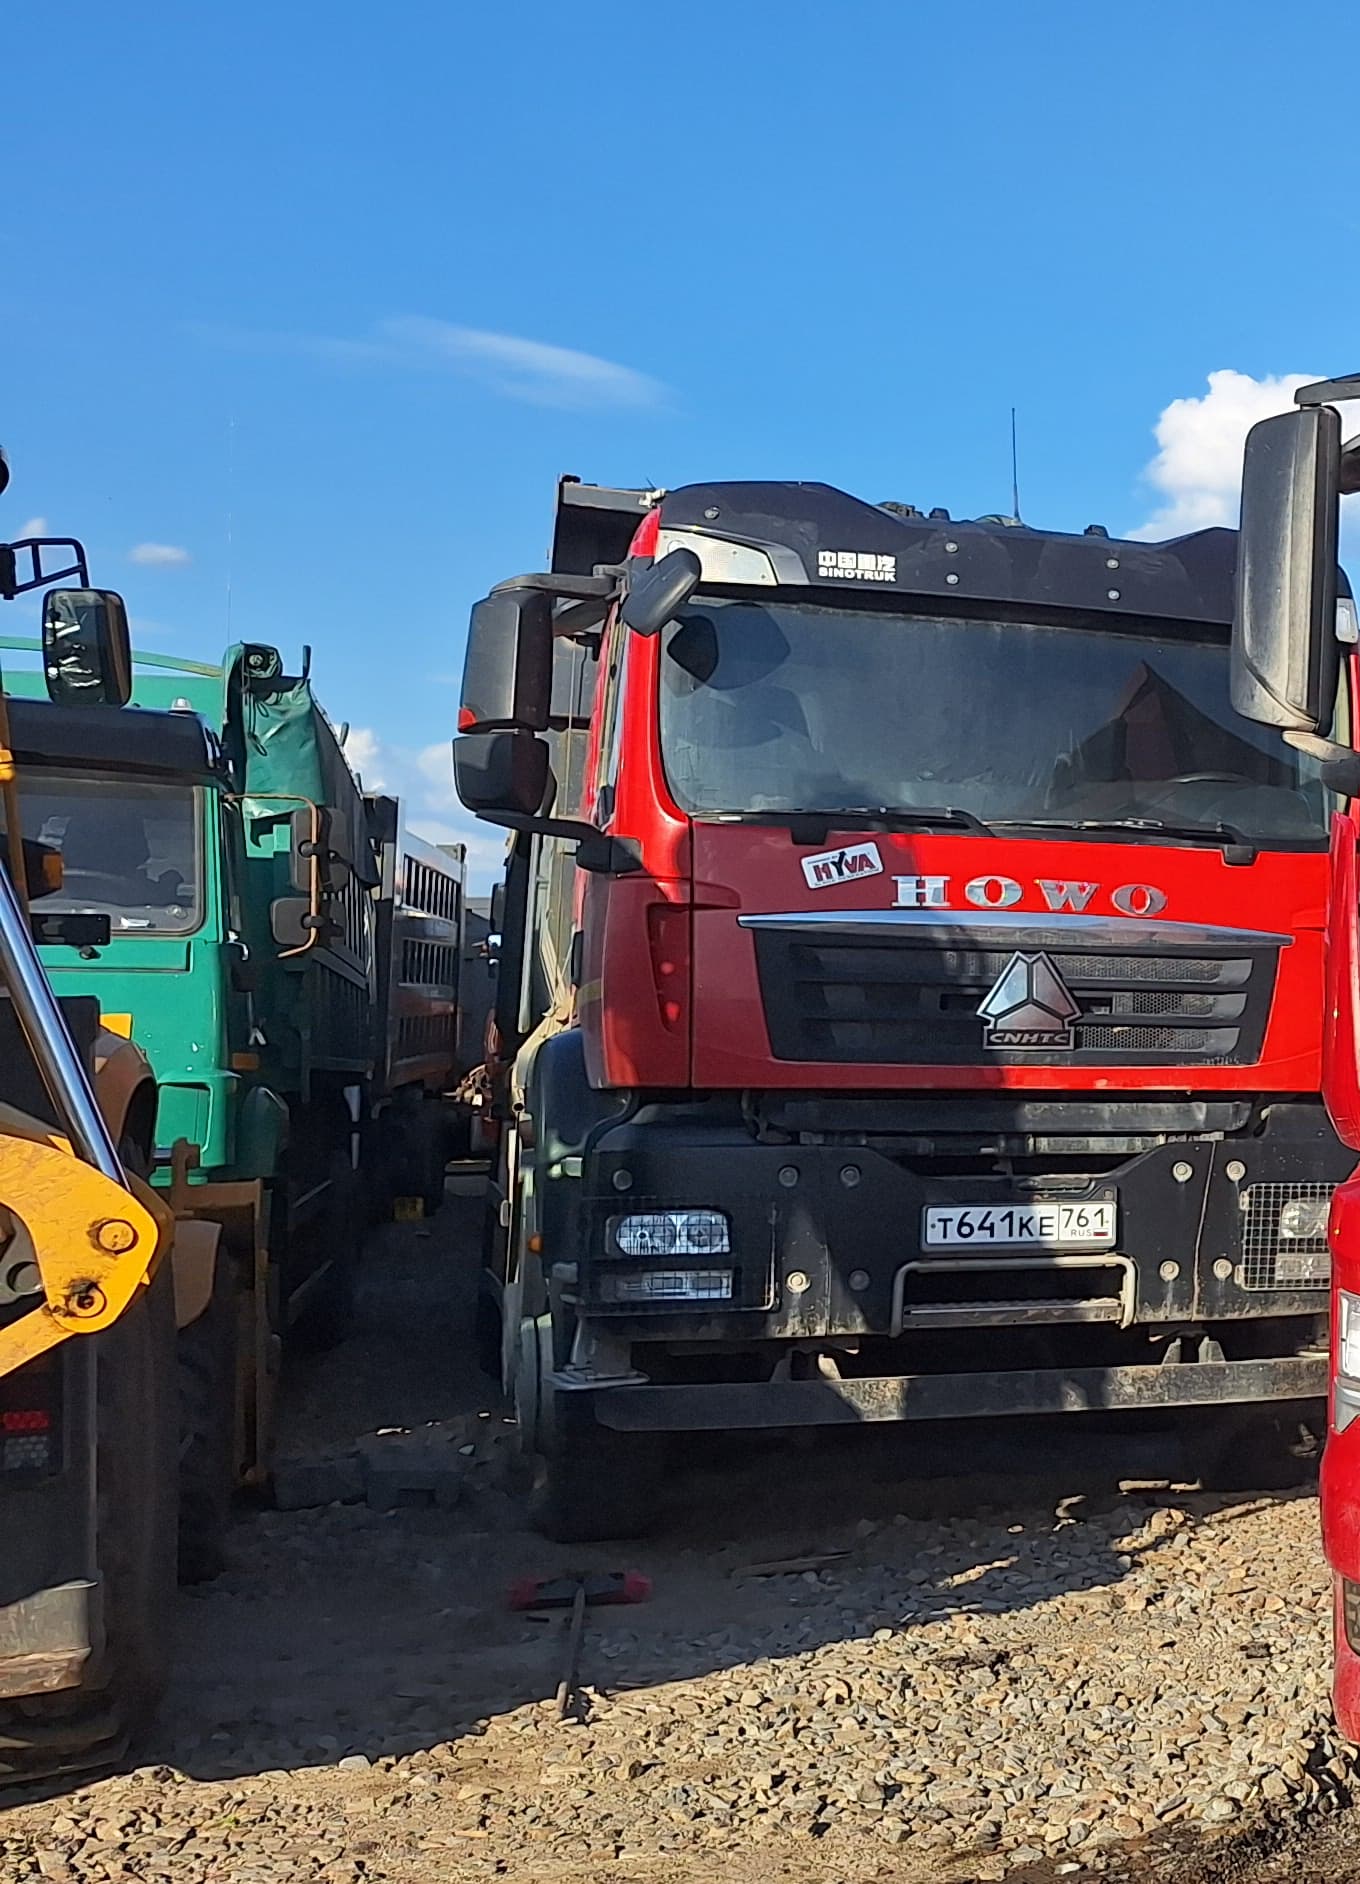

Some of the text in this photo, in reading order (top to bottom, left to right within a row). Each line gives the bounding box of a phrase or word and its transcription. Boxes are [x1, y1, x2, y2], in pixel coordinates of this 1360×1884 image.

[818, 567, 897, 582] SINOTRUK
[813, 851, 876, 882] HYVA
[891, 875, 1168, 917] HOWO
[989, 1032, 1069, 1044] CNHTC
[1062, 1207, 1106, 1229] 761
[1071, 1229, 1092, 1237] RUS
